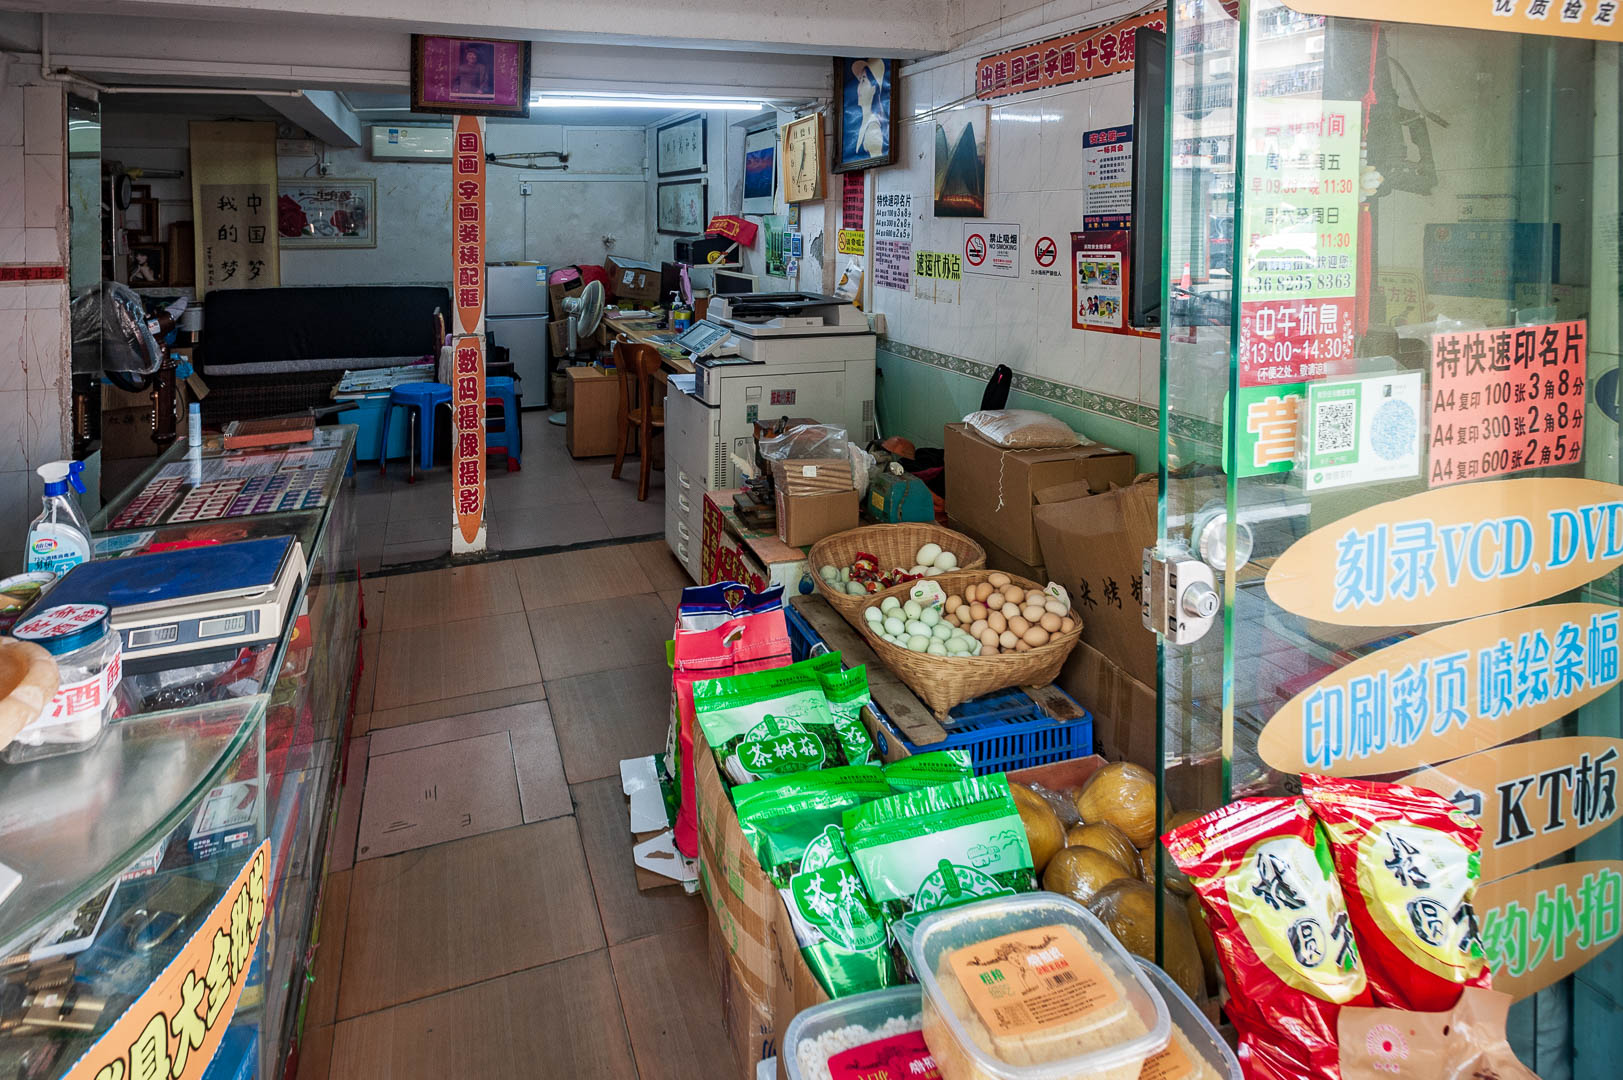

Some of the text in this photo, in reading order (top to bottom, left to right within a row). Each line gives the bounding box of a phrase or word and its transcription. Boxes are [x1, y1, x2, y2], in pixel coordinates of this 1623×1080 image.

[1324, 179, 1353, 194] 11:30
[217, 195, 239, 282] 我的梦
[247, 193, 266, 281] 中国梦
[459, 134, 479, 307] 国画 字画装裱配框
[989, 233, 1017, 244] 禁止吸烟
[1320, 232, 1350, 249] 11:30
[1317, 272, 1351, 290] 8363
[1256, 303, 1338, 338] 中午休息
[1251, 338, 1342, 363] 13:00~14:30
[1436, 324, 1583, 379] 特快速印名片
[458, 348, 479, 515] 数码摄像摄影
[1304, 611, 1619, 767] 印刷彩页 喷绘条幅
[747, 737, 818, 768] 茶树菇
[1495, 747, 1618, 847] KT板
